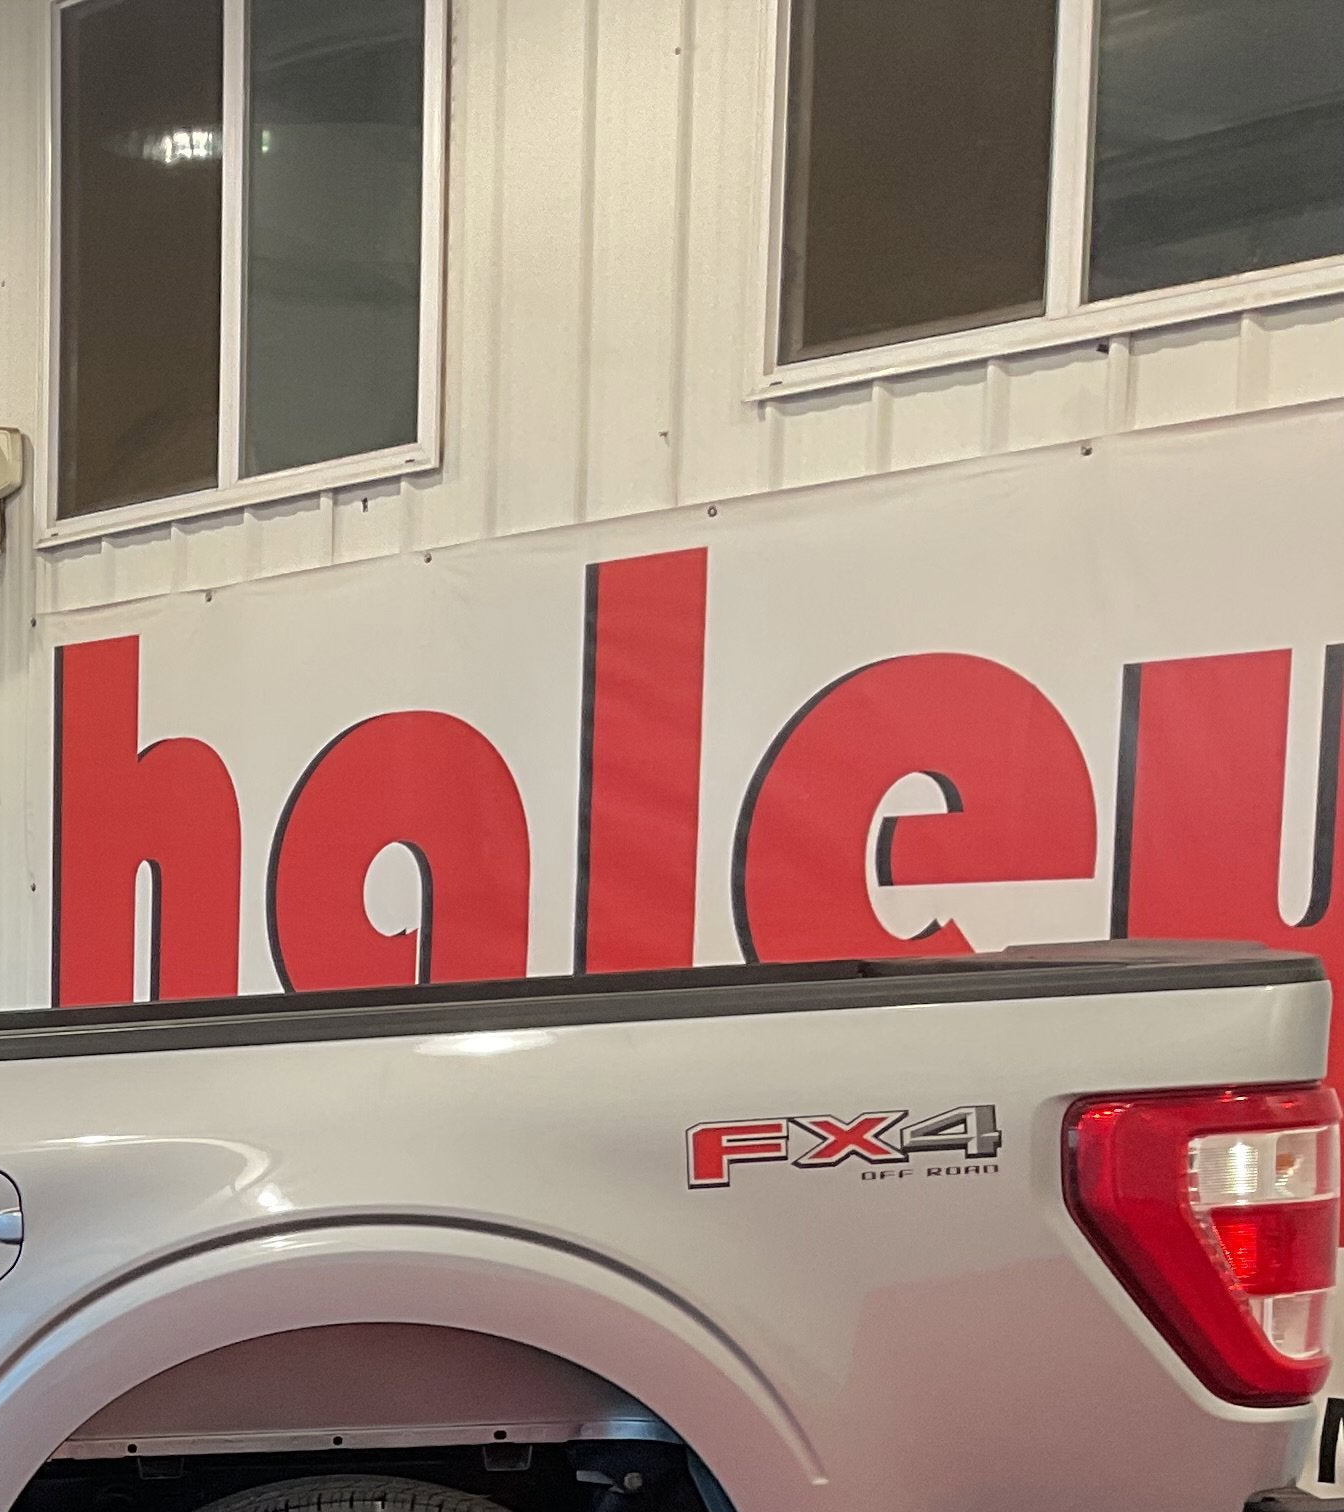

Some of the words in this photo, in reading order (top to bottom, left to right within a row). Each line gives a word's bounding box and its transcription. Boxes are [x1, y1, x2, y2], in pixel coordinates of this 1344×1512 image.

[685, 1104, 1002, 1190] FX4
[861, 1168, 914, 1181] OFF
[926, 1164, 1000, 1177] ROAD
